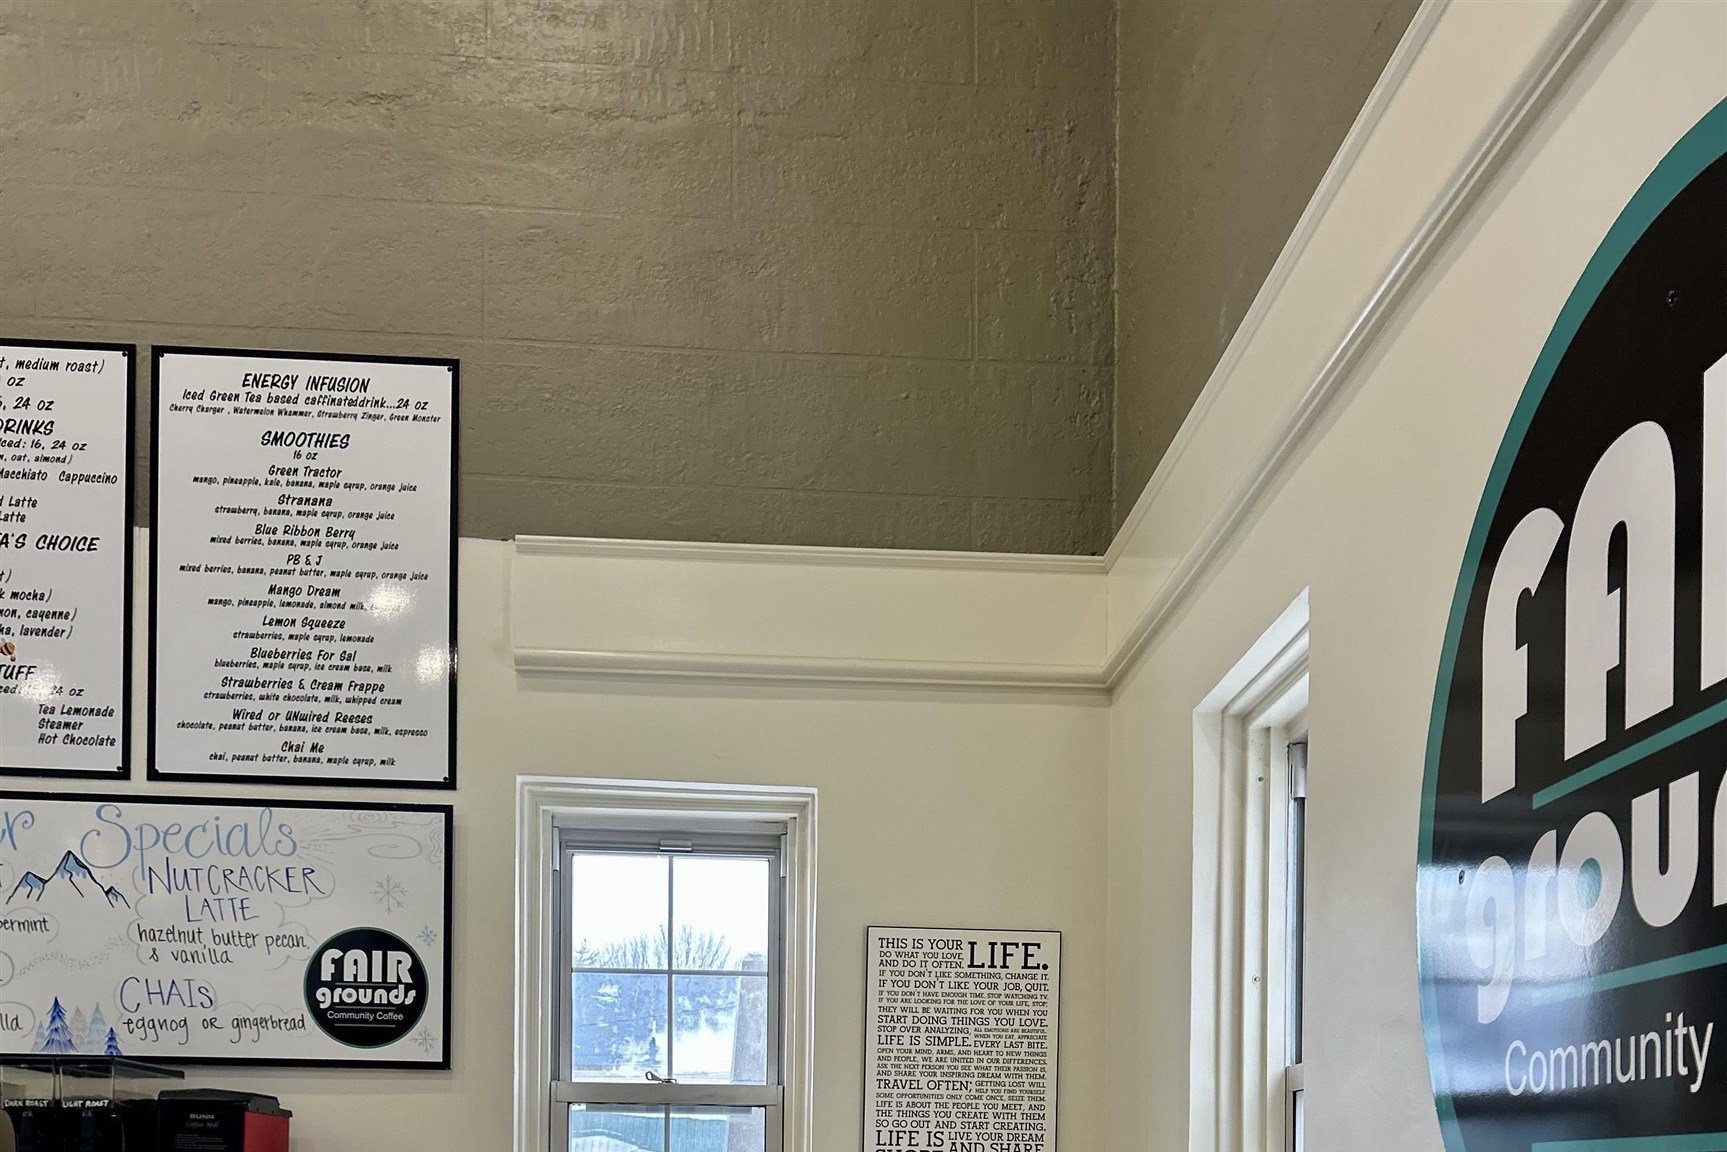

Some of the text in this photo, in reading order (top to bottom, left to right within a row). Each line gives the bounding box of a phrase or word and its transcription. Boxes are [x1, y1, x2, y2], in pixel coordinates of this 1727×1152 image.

[15, 358, 105, 374] medium roast)
[7, 377, 25, 387] oz
[241, 372, 371, 393] ENERGY INFUSION
[13, 396, 54, 411] 24 oz
[182, 388, 205, 401] Iced
[209, 389, 240, 402] Green
[245, 391, 262, 403] Tea
[266, 391, 300, 405] based
[414, 400, 428, 410] oz
[51, 440, 67, 450] 24
[72, 442, 87, 451] oz
[260, 430, 350, 449] SMOOTHIES
[34, 454, 73, 464] almond)
[293, 449, 318, 460] 16 oz
[59, 471, 118, 485] Cappuccino
[268, 464, 342, 478] Green Tractor
[8, 496, 38, 508] Latte
[277, 493, 333, 507] Stranana
[254, 523, 356, 540] Blue Ribbon Berry
[35, 534, 100, 552] CHOICE
[286, 553, 323, 566] PB & J
[10, 588, 53, 603] mocha)
[267, 583, 341, 598] Mango Dream
[26, 607, 77, 622] cayenne)
[262, 615, 345, 631] Lemon Squeeze
[20, 624, 74, 639] lavender)
[249, 646, 357, 662] Blueberries For Sal
[220, 675, 385, 694] Strawberries & Cream Frappe
[69, 688, 85, 697] oz
[38, 704, 115, 717] Tea Lemonade
[232, 708, 373, 724] Wired or UNwired Reeses
[38, 718, 84, 731] Steamer
[38, 733, 117, 747] Hot Chocolate
[280, 740, 324, 753] Chai Me
[81, 804, 298, 880] Specials
[148, 857, 326, 895] NUTCRACKER
[1467, 768, 1727, 1024] grou
[186, 895, 259, 922] LATTE
[212, 928, 260, 949] butter
[878, 937, 964, 951] THIS IS YOUR
[171, 946, 233, 964] vanilla
[879, 950, 964, 961] DO WHAT YOU LOVE,
[967, 940, 1049, 971] LIFE.
[321, 948, 413, 983] FAIR
[878, 958, 964, 969] AND DO IT OFTEN.
[878, 969, 1049, 981] IF YOU DON'T LIKE SOMETHING, CHANGE IT.
[878, 978, 1049, 993] IF YOU DON'T LIKE YOUR JOB, QUIT.
[316, 984, 416, 1009] grounds
[327, 1011, 404, 1021] Community Coffee
[877, 1014, 1048, 1027] START DOING THINGS YOU LOVE.
[122, 1017, 189, 1045] eggnog
[231, 1014, 306, 1043] gingerbread
[877, 1034, 972, 1047] LIFE IS SIMPLE.
[973, 1039, 1048, 1049] EVERY LAST BITE.
[1505, 1012, 1714, 1096] Community
[875, 1078, 972, 1093] TRAVEL OFTEN;
[62, 1100, 83, 1108] LIGHT
[875, 1118, 1046, 1131] SO GO OUT AND START CREATING.
[875, 1129, 944, 1147] LIFE IS
[947, 1131, 1044, 1142] LIVE YOUR DREAM
